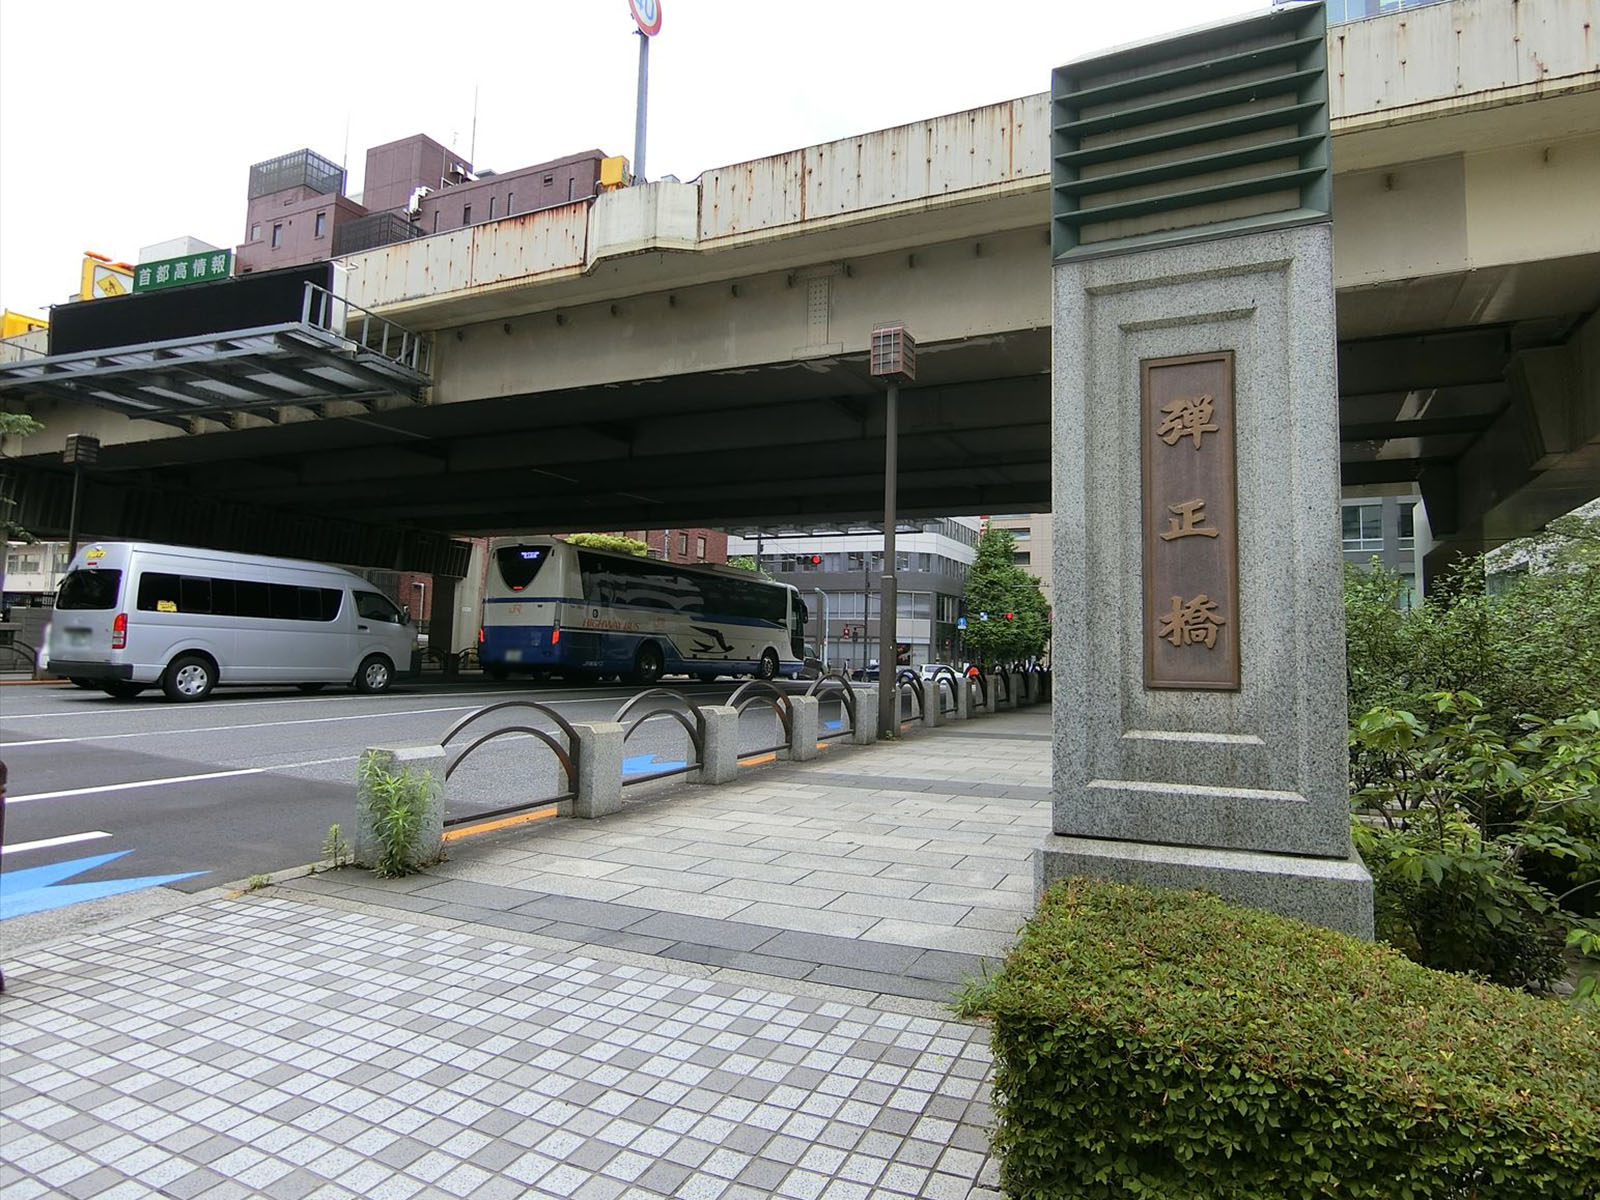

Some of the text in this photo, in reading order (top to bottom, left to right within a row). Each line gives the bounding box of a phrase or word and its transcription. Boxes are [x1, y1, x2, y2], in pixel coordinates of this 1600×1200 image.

[139, 254, 226, 286] 首都高情報
[583, 618, 621, 629] HIGHWAY
